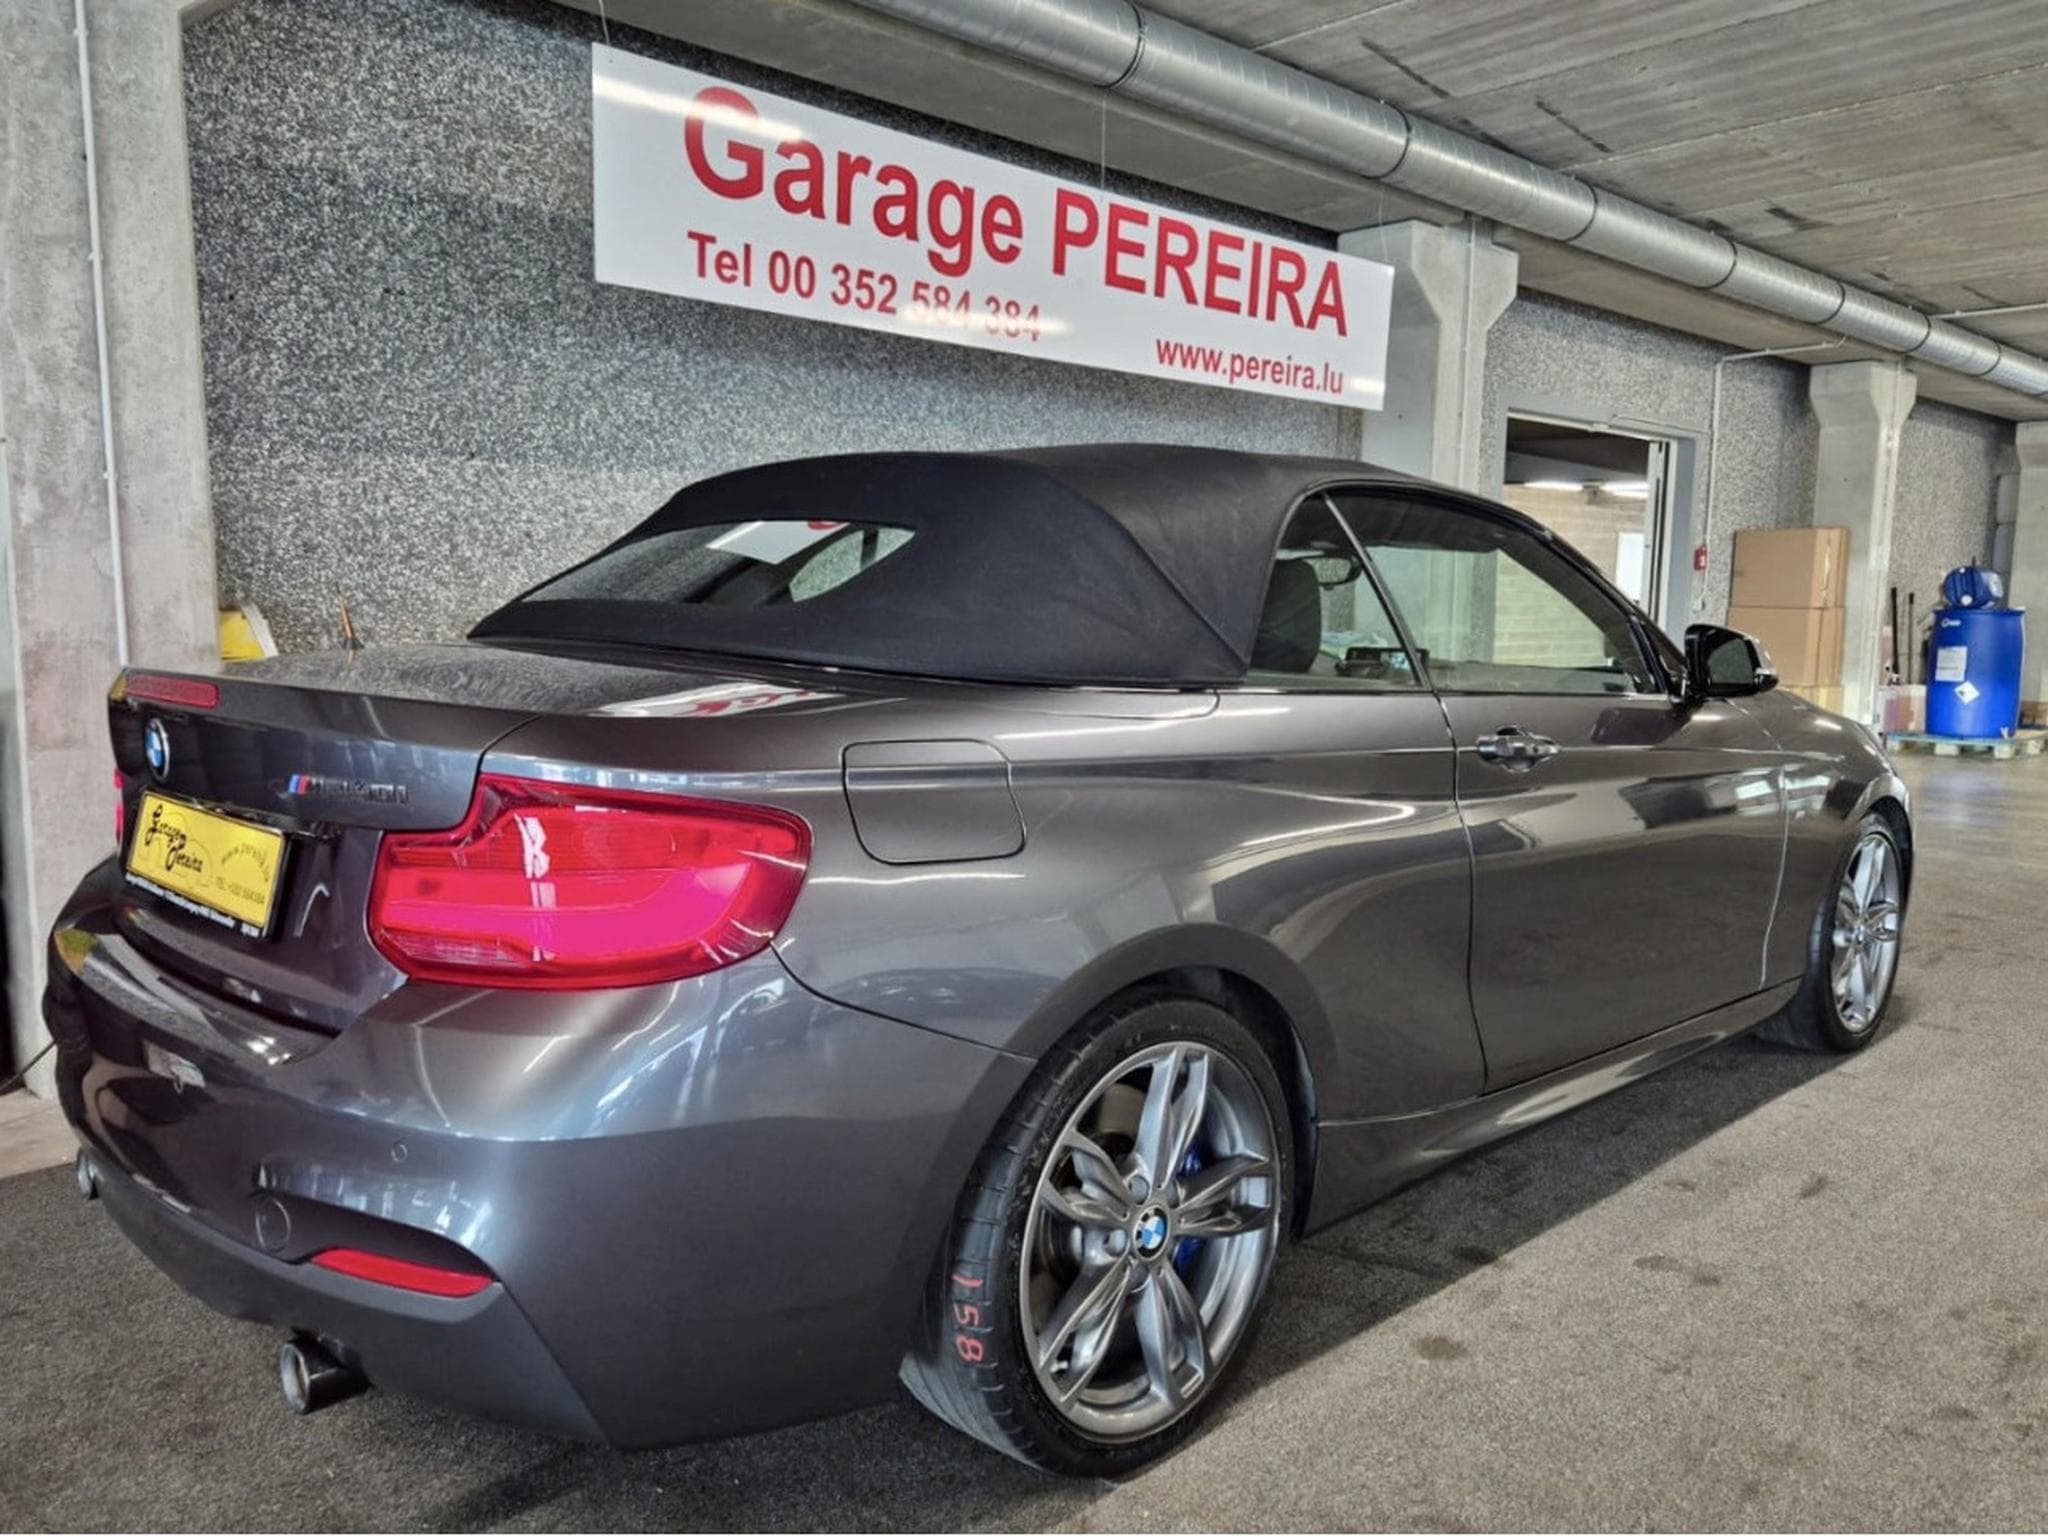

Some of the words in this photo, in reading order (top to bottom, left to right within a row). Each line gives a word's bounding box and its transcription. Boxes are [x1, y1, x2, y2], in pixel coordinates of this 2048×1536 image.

[684, 86, 1023, 278] Garage
[1053, 187, 1347, 338] PEREIRA
[687, 230, 752, 287] Tel
[768, 250, 817, 299] 00
[831, 263, 897, 315] 352
[1156, 338, 1344, 395] www.pereira.lu
